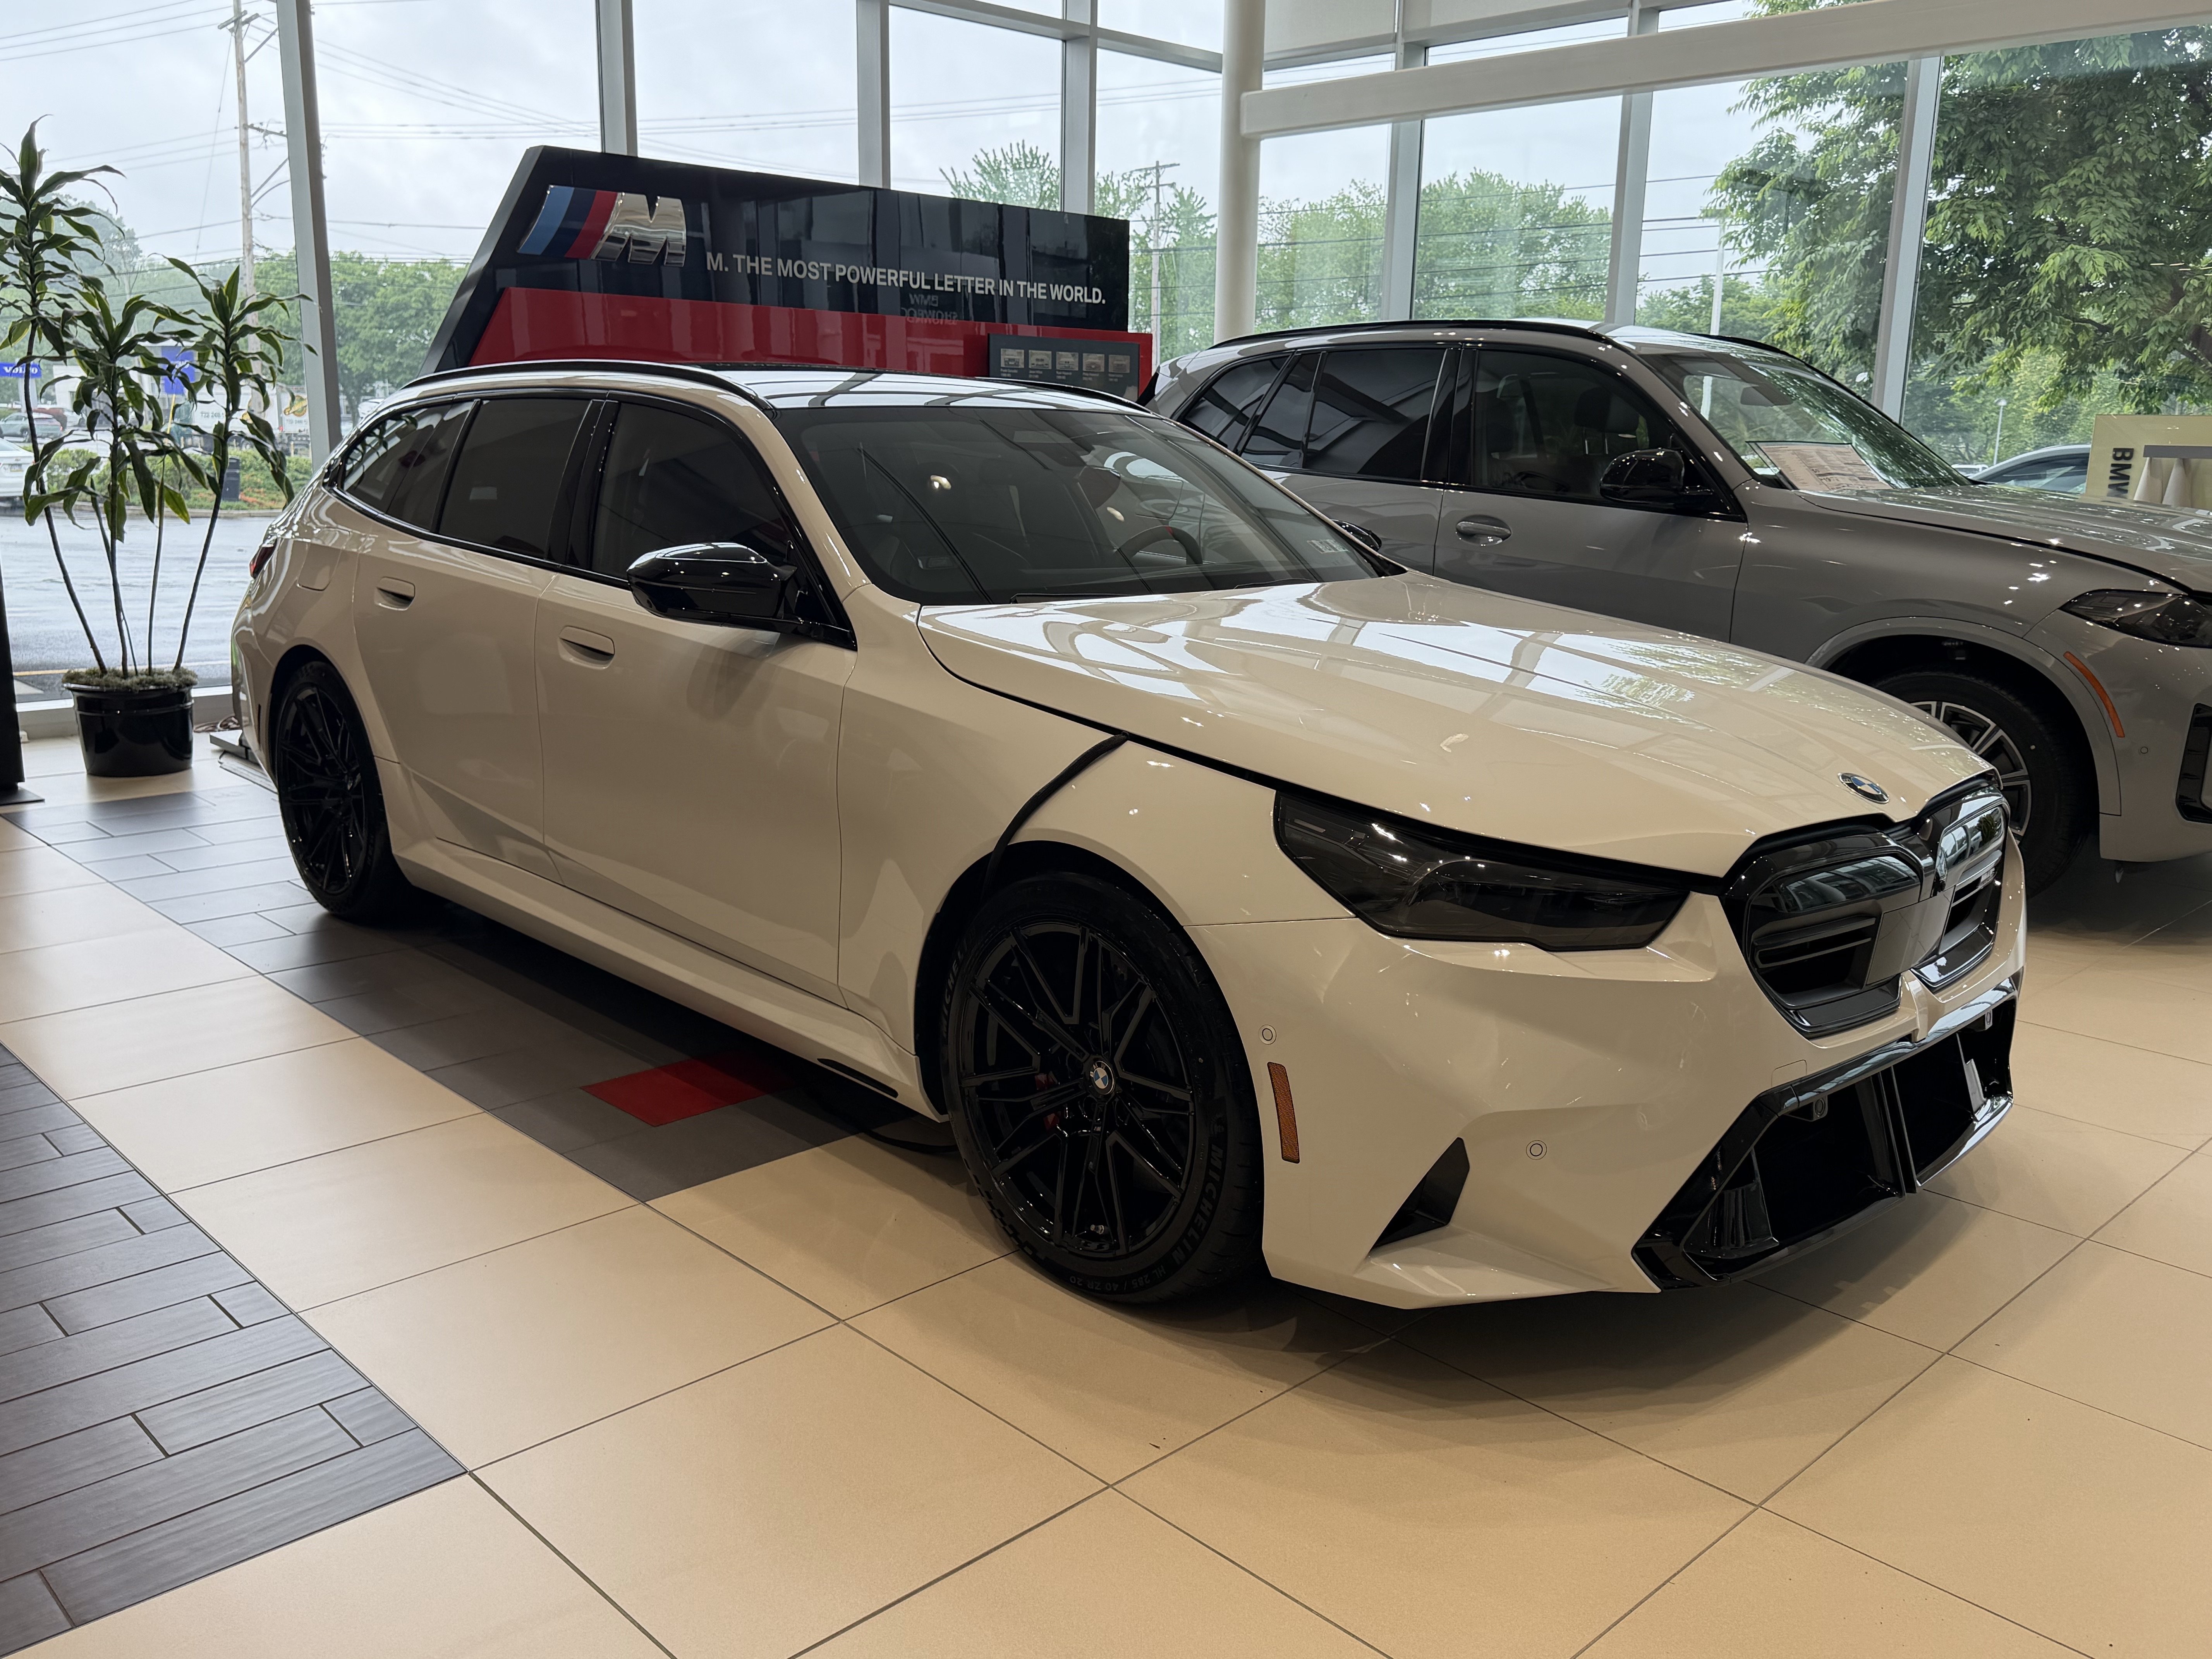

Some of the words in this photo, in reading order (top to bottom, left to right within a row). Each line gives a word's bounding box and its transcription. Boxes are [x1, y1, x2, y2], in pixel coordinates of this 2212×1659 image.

[706, 252, 728, 271] M.
[733, 254, 773, 276] THE
[777, 258, 832, 280] MOST
[835, 263, 931, 290] POWERFUL
[934, 273, 995, 295] LETTER
[999, 279, 1014, 297] IN
[1017, 280, 1047, 299] THE
[1049, 283, 1106, 304] WORLD.
[1171, 1143, 1224, 1264] MICHELIN
[1069, 1276, 1084, 1286] 20
[1087, 1280, 1102, 1290] ZR
[1105, 1282, 1119, 1291] 40
